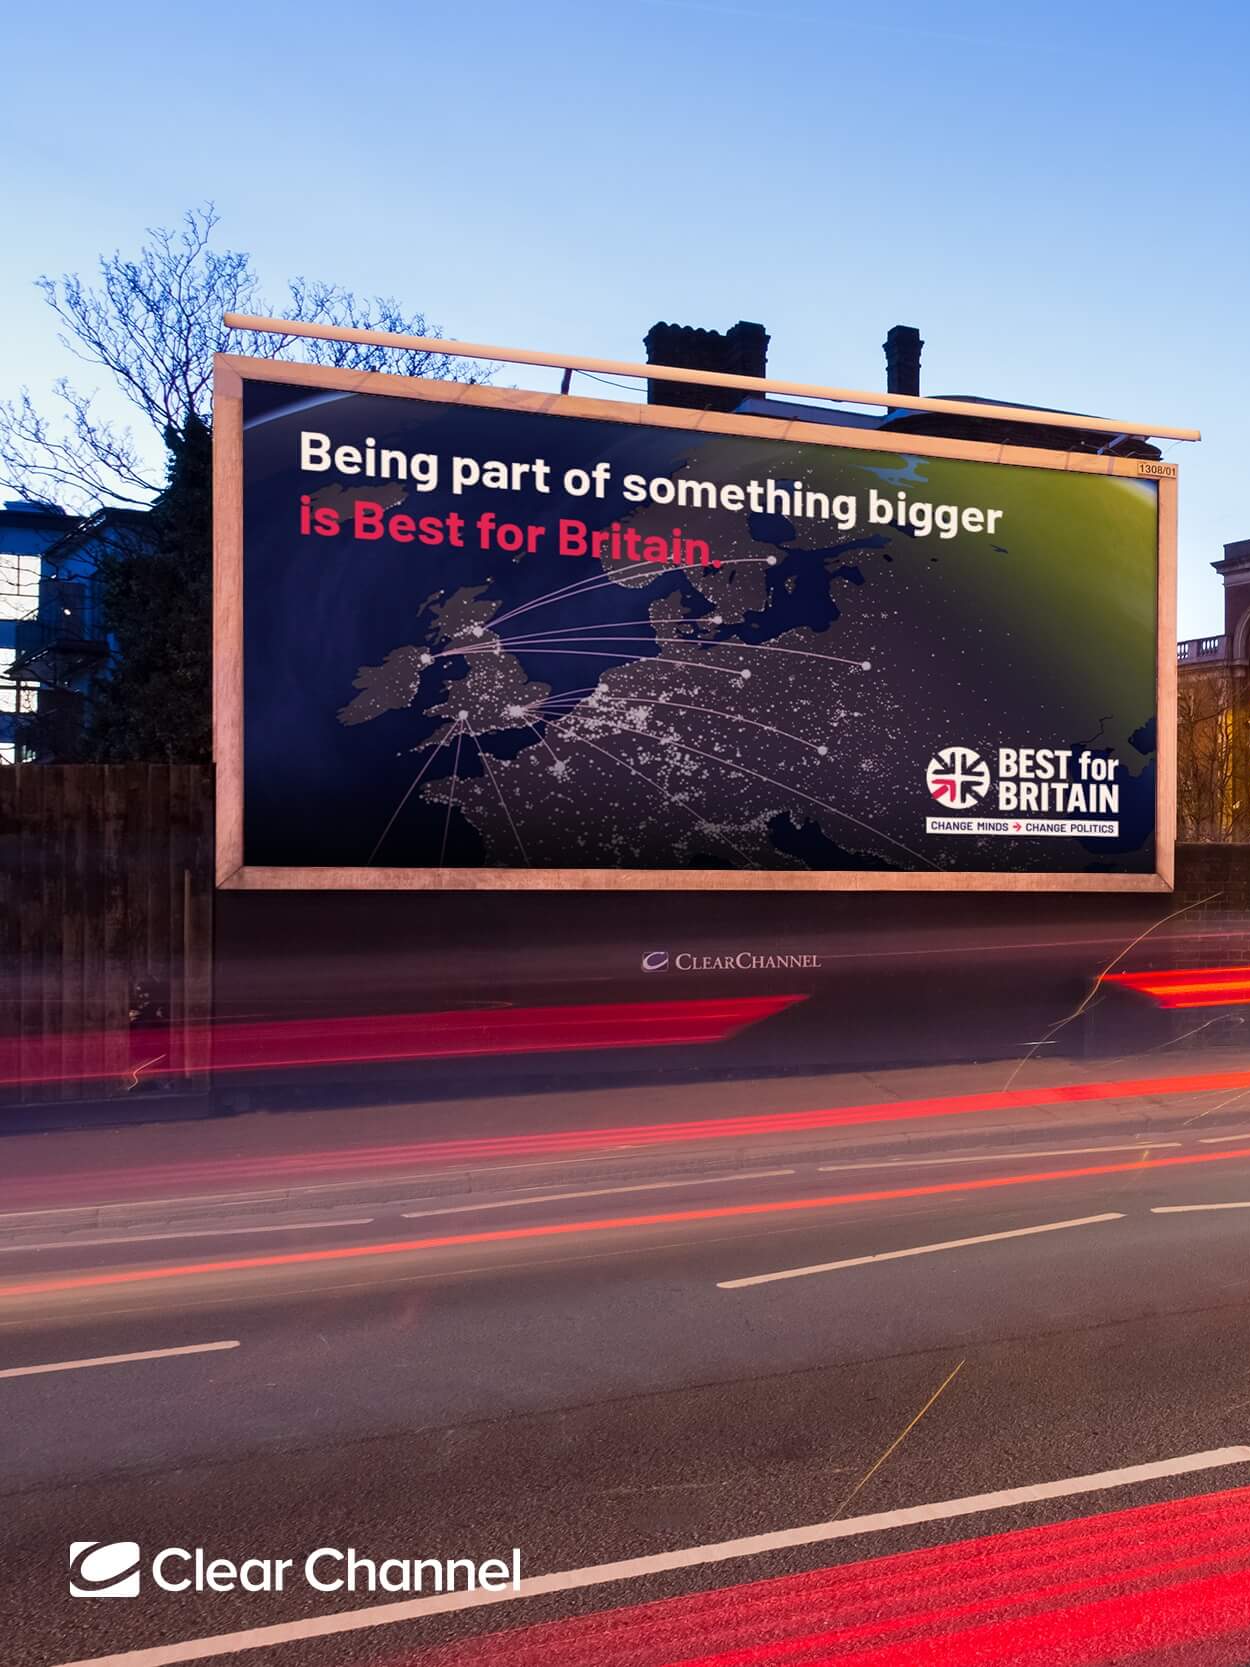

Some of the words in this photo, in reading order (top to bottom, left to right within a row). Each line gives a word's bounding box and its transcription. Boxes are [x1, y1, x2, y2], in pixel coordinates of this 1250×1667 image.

[301, 431, 438, 492] Being
[452, 456, 551, 495] part
[563, 463, 611, 498] of
[622, 473, 857, 530] something
[868, 489, 1004, 539] bigger
[1140, 464, 1176, 476] 1308/01
[300, 495, 340, 535] is
[354, 500, 465, 547] Best
[477, 513, 546, 553] for
[559, 519, 723, 570] Britain.
[999, 748, 1072, 779] BEST
[1079, 751, 1119, 781] for
[999, 780, 1119, 813] BRITAIN
[931, 820, 973, 831] CHANGE
[977, 822, 1009, 831] MINDS
[1025, 823, 1067, 833] CHANGE
[1070, 824, 1114, 834] POLITICS
